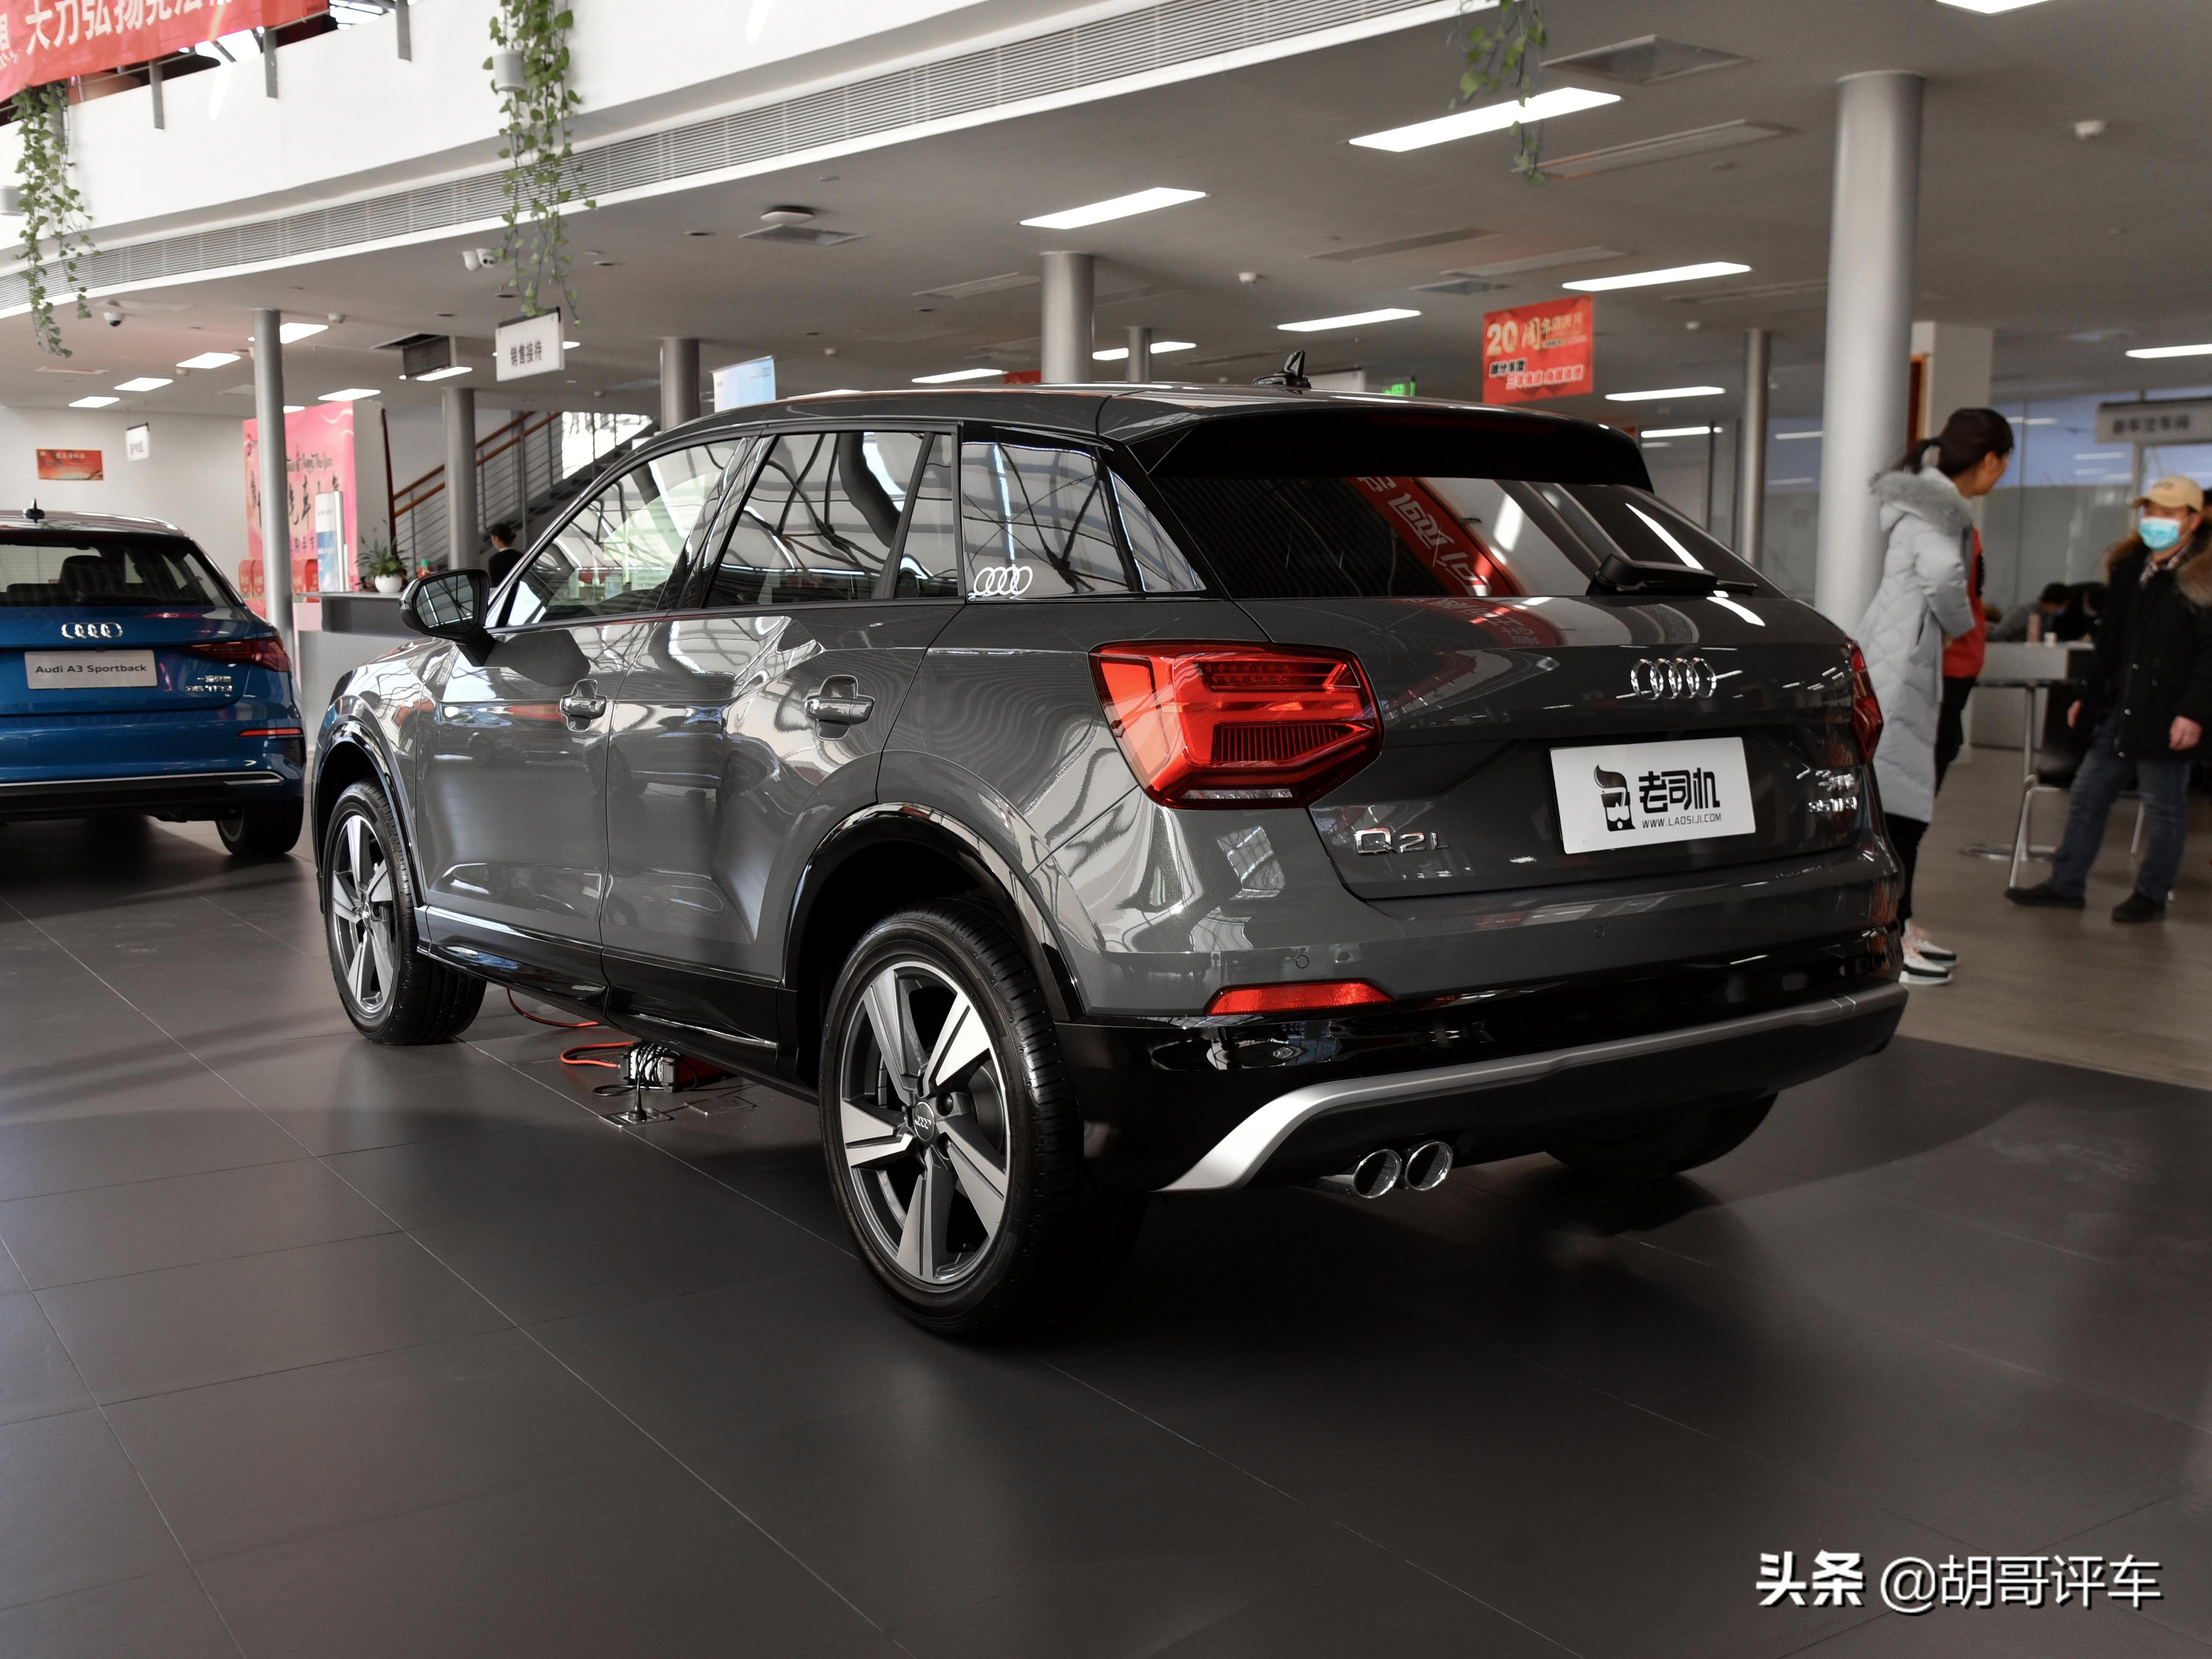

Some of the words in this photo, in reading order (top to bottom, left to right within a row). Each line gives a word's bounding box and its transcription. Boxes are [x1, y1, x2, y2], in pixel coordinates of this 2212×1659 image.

[510, 339, 541, 366] 销售接待
[36, 665, 63, 673] Audi
[67, 665, 83, 673] A3
[87, 664, 147, 674] Sportback
[1638, 767, 1721, 814] 老司机
[1642, 812, 1722, 829] WWW.LAOSIJI.COM
[1354, 826, 1450, 855] Q2L
